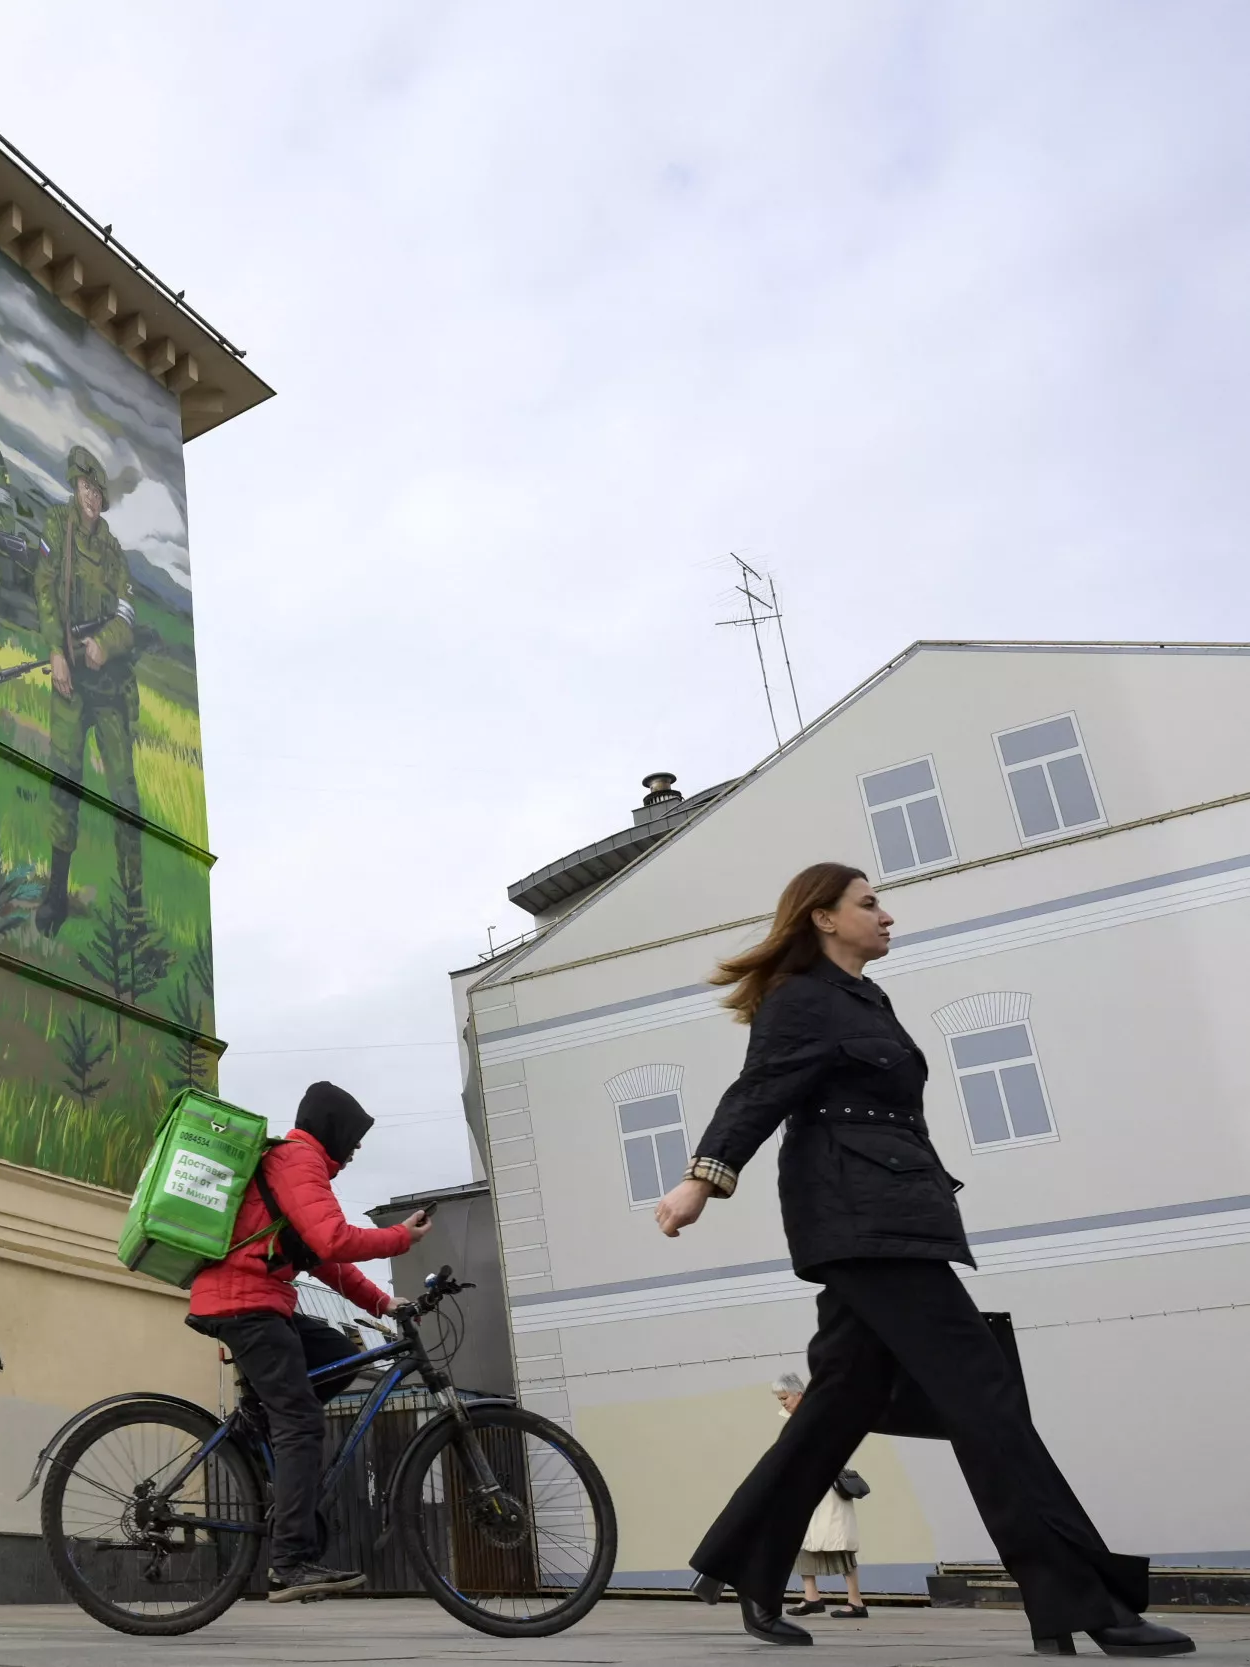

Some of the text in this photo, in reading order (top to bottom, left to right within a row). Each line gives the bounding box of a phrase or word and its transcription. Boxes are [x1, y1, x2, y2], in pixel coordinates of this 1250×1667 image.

[174, 1169, 212, 1189] еды от
[177, 1154, 228, 1181] Доставка
[171, 1181, 220, 1206] 15 минут
